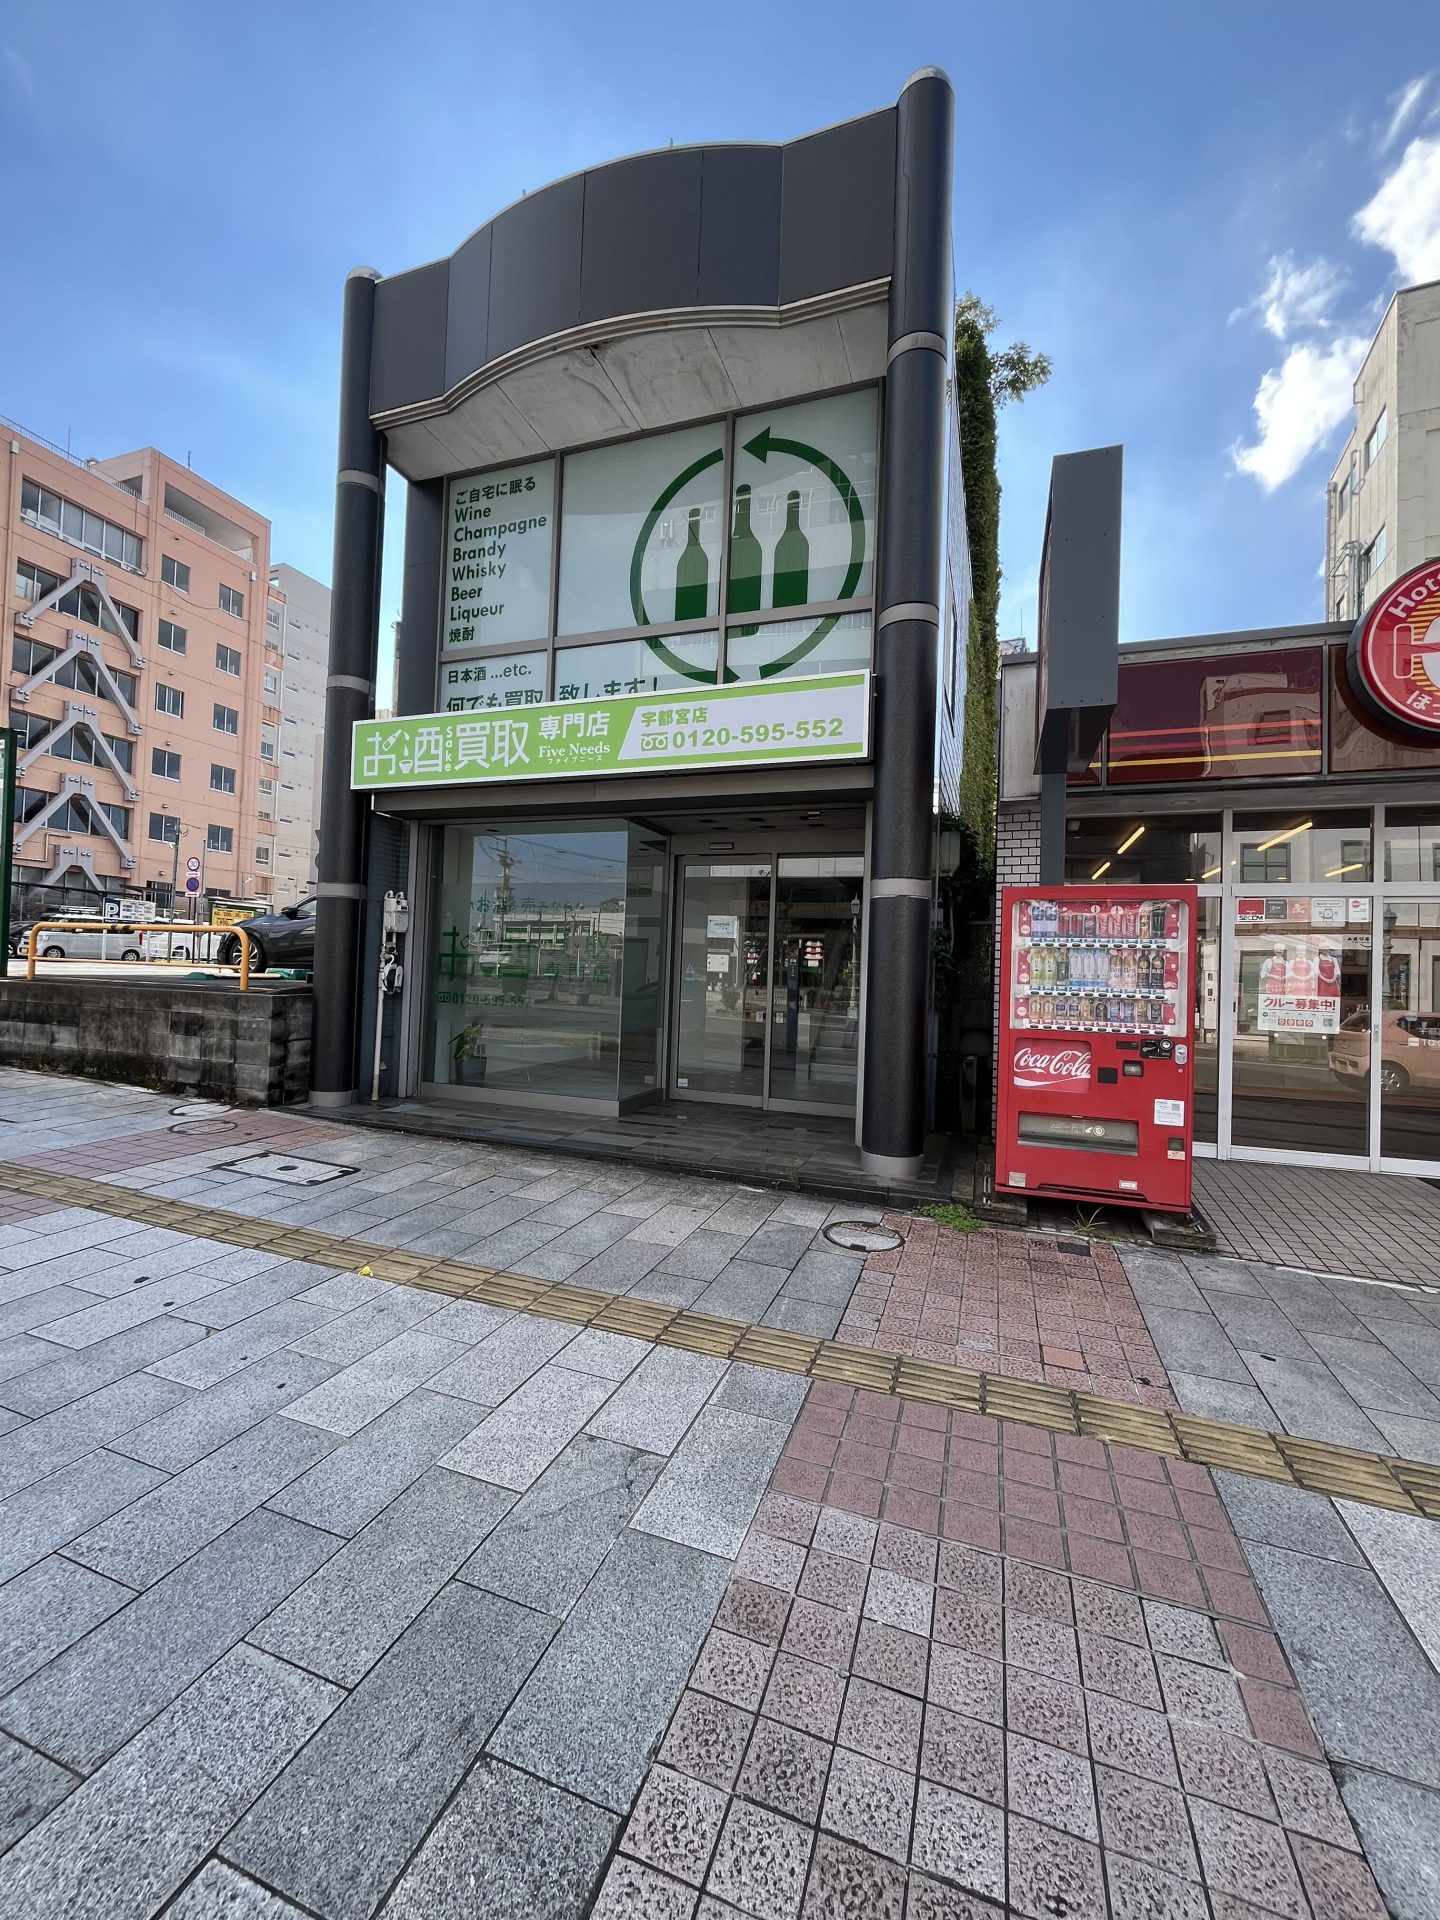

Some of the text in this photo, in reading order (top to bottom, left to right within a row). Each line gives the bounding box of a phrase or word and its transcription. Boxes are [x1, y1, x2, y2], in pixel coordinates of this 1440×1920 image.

[456, 476, 536, 505] ご自宅に眠る
[455, 506, 492, 523] Wine
[453, 516, 547, 542] Champagne
[453, 540, 506, 563] Brandy
[452, 561, 507, 581] Whisky
[451, 586, 483, 601] Beer
[1387, 573, 1440, 618] Hot
[450, 603, 505, 623] Liqueur
[448, 625, 475, 643] 焼酎
[448, 666, 487, 684] 日本酒
[538, 711, 611, 740] 専門店
[641, 706, 708, 728] 宇都宮店
[672, 718, 844, 749] 0120-595-552
[538, 741, 611, 758] Five Needs
[1263, 997, 1336, 1011] クルー募集中!
[1013, 1047, 1091, 1077] Coca-Cola
